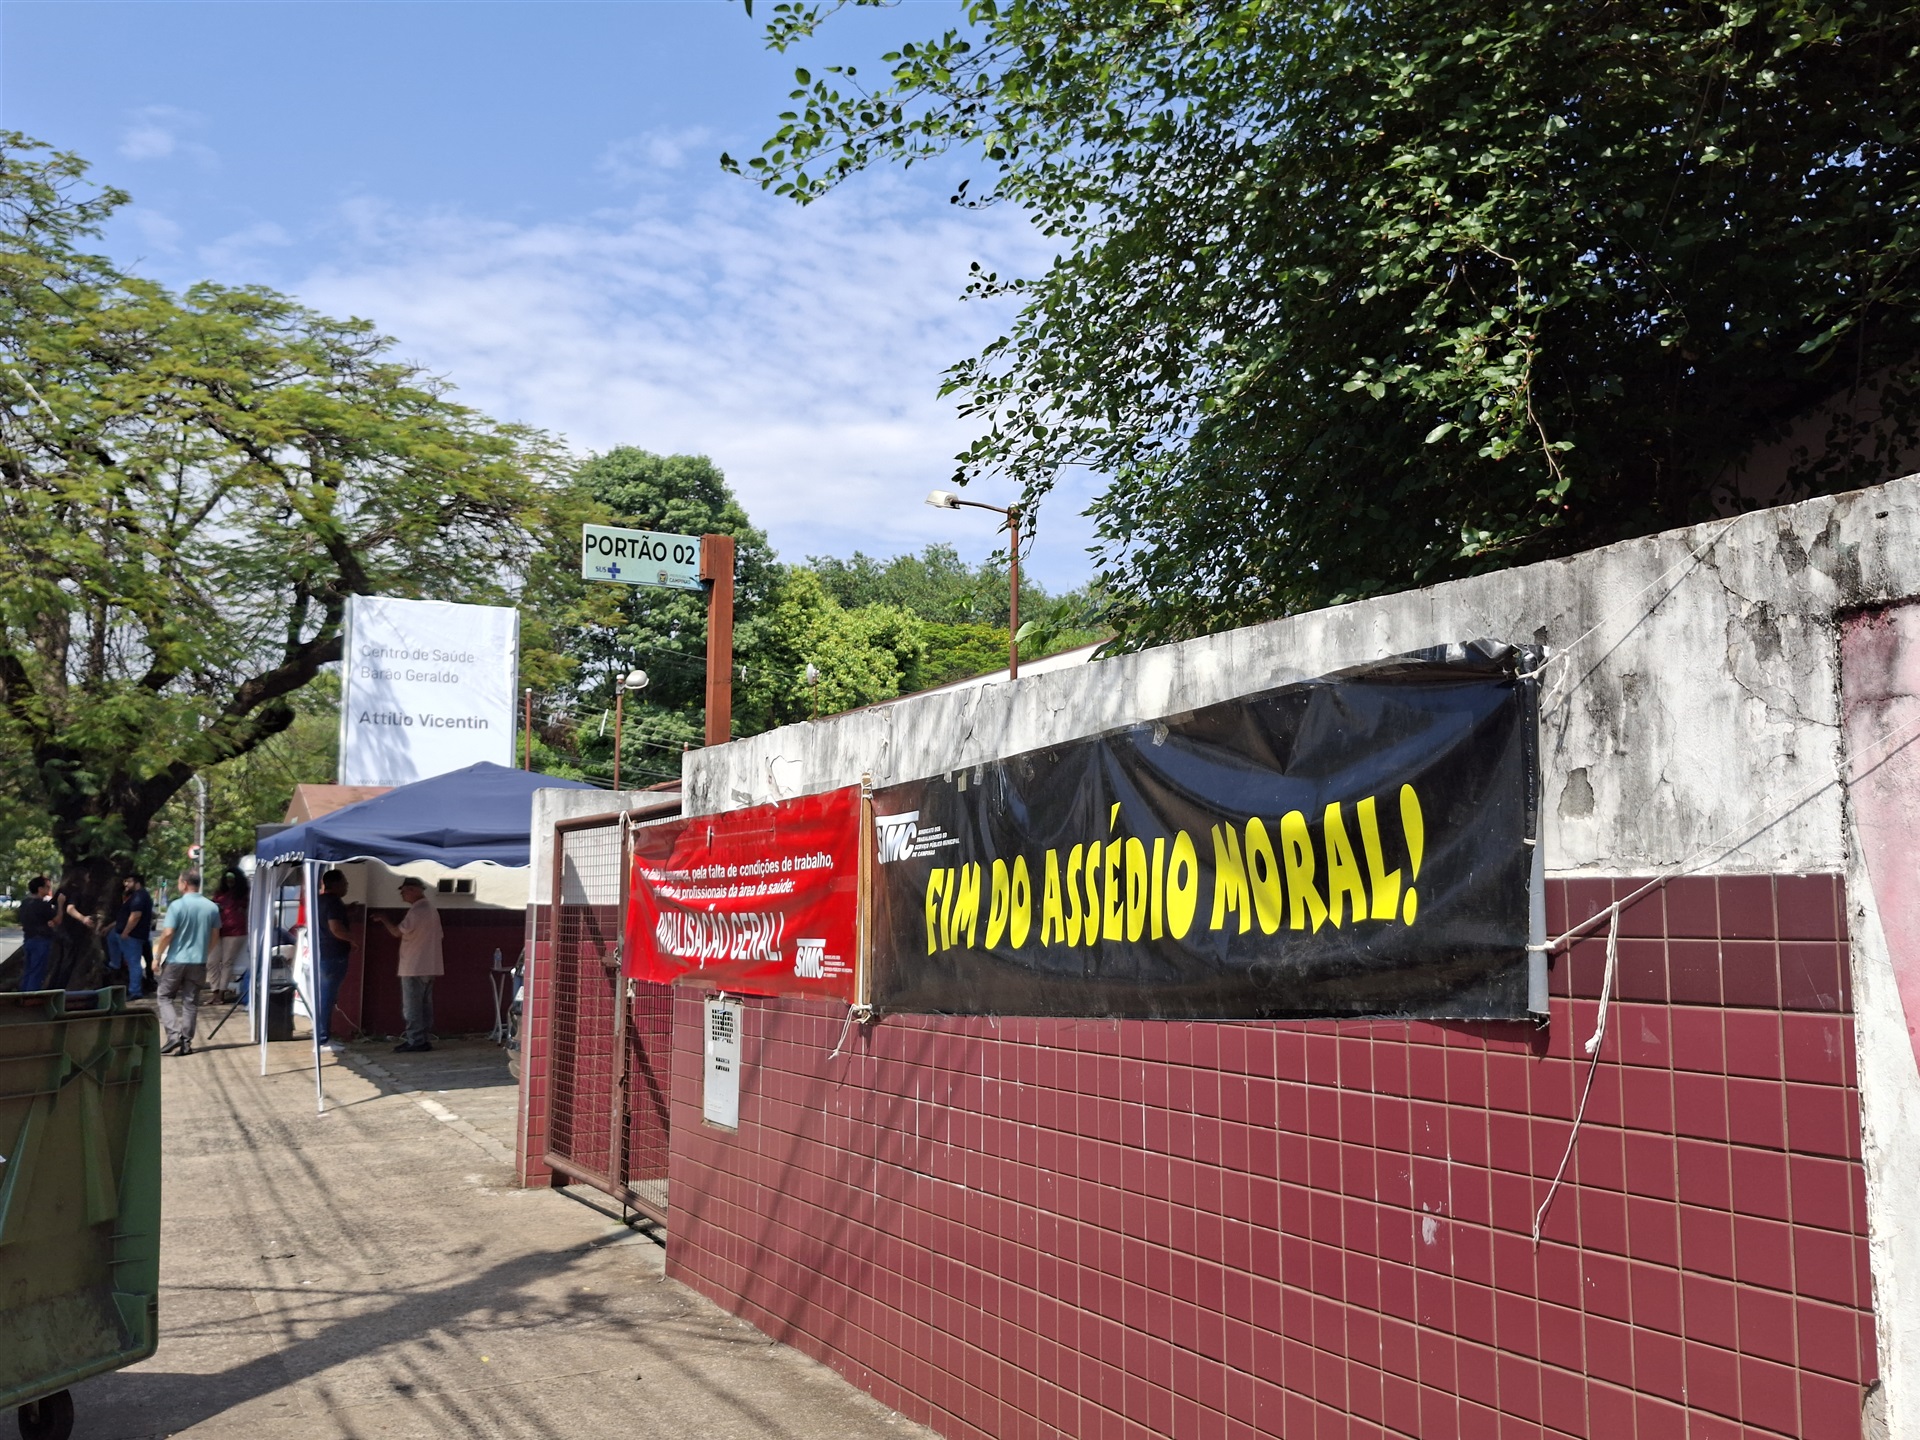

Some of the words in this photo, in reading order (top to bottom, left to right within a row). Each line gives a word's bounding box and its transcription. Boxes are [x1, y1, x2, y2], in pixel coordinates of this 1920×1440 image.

[585, 534, 667, 562] PORTÃO
[673, 544, 695, 565] 02
[361, 644, 409, 660] Centro
[412, 648, 429, 661] de
[433, 649, 475, 663] Saúde
[361, 666, 401, 681] Barão
[405, 669, 459, 684] Geraldo
[359, 711, 413, 727] Attilio
[419, 713, 489, 729] Vicentin
[692, 864, 707, 882] pela
[708, 863, 726, 879] falta
[727, 862, 738, 878] de
[739, 859, 780, 880] condições
[781, 856, 793, 873] de
[794, 851, 834, 871] trabalho,
[926, 861, 981, 956] FIM
[984, 854, 1031, 950] DO
[1040, 801, 1198, 948] ASSÉDIO
[1210, 783, 1424, 935] MORAL!
[681, 884, 727, 901] profissionais
[728, 883, 738, 898] da
[738, 881, 756, 897] área
[757, 879, 767, 896] de
[767, 878, 796, 895] saúde:
[655, 903, 730, 969] PARALISAÇÃO
[730, 911, 785, 962] GERAL!
